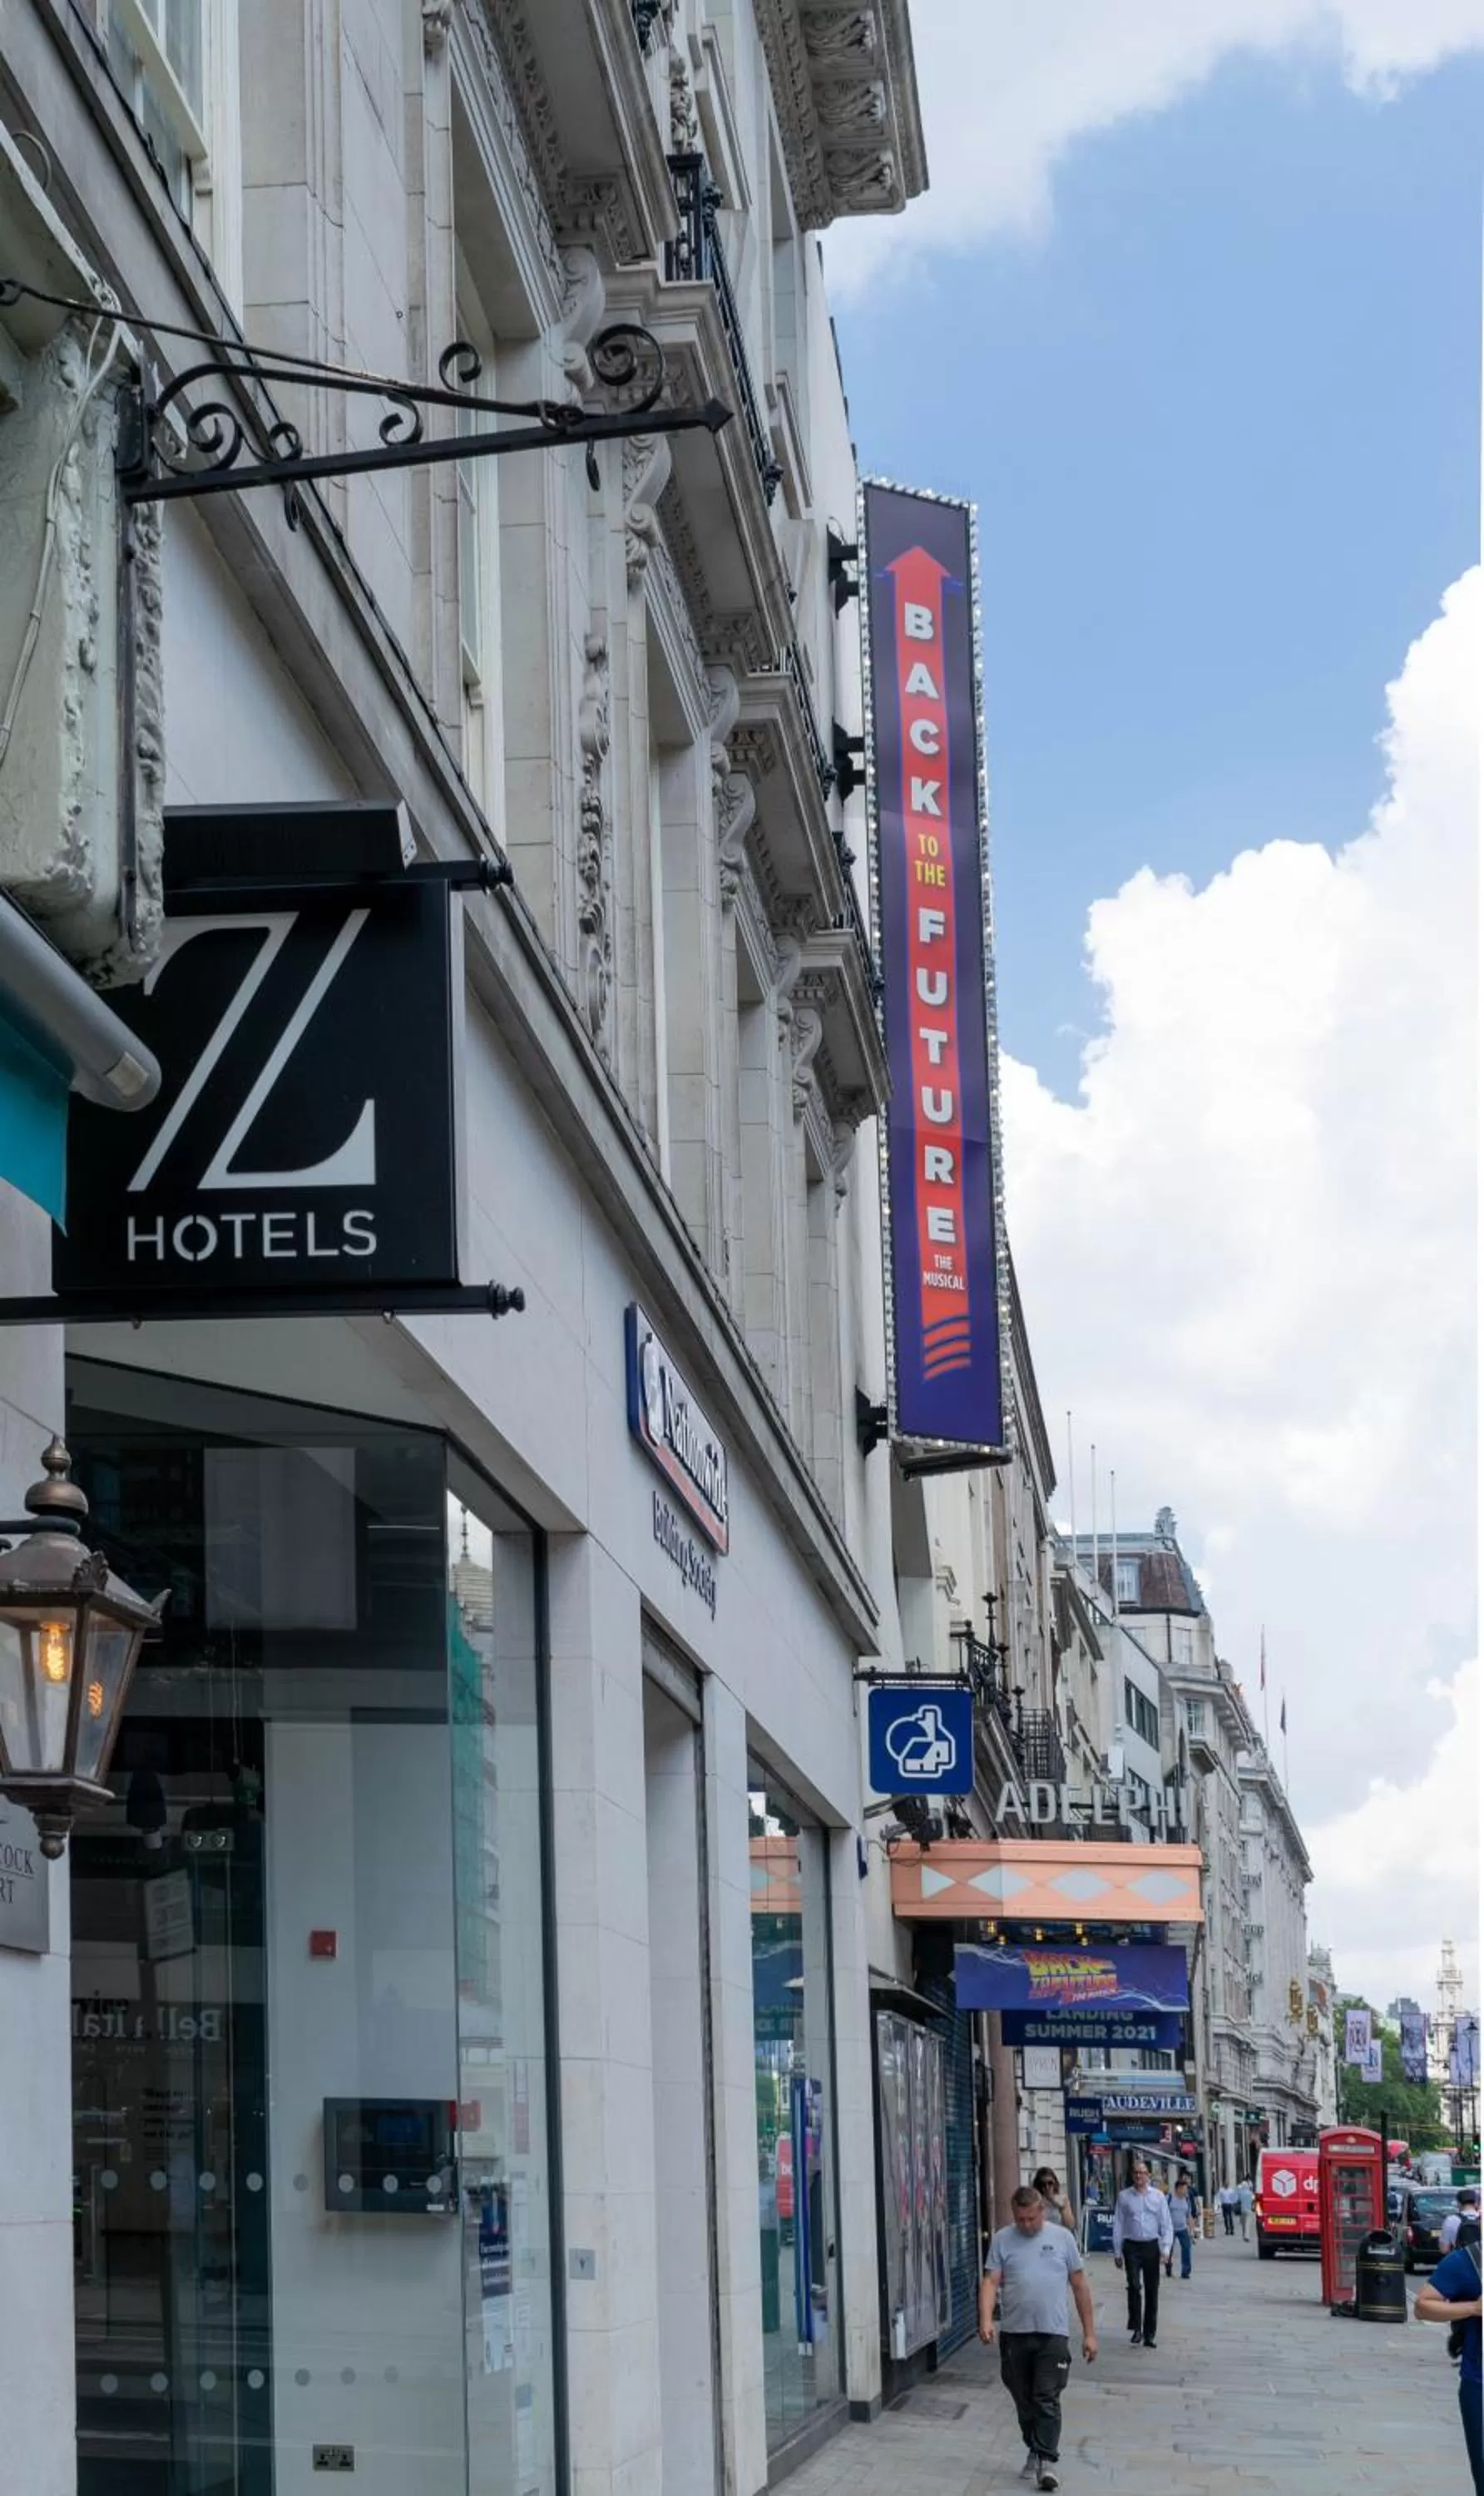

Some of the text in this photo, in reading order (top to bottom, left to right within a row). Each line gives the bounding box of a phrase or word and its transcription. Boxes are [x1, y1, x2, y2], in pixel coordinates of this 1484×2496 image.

[904, 602, 942, 817] BACK
[918, 833, 938, 859] TO
[915, 859, 946, 887] THE
[916, 907, 955, 1244] FUTURE
[127, 1211, 377, 1261] HOTELS
[933, 1254, 952, 1270] THE
[923, 1271, 965, 1291] MUSICAL
[995, 1780, 1188, 1827] ADELPHI
[0, 1845, 33, 1874] OCK
[1046, 2009, 1134, 2021] LANDING
[1024, 2023, 1156, 2040] SUMMER 2021
[1303, 2176, 1320, 2194] dp
[1097, 2213, 1115, 2224] RU
